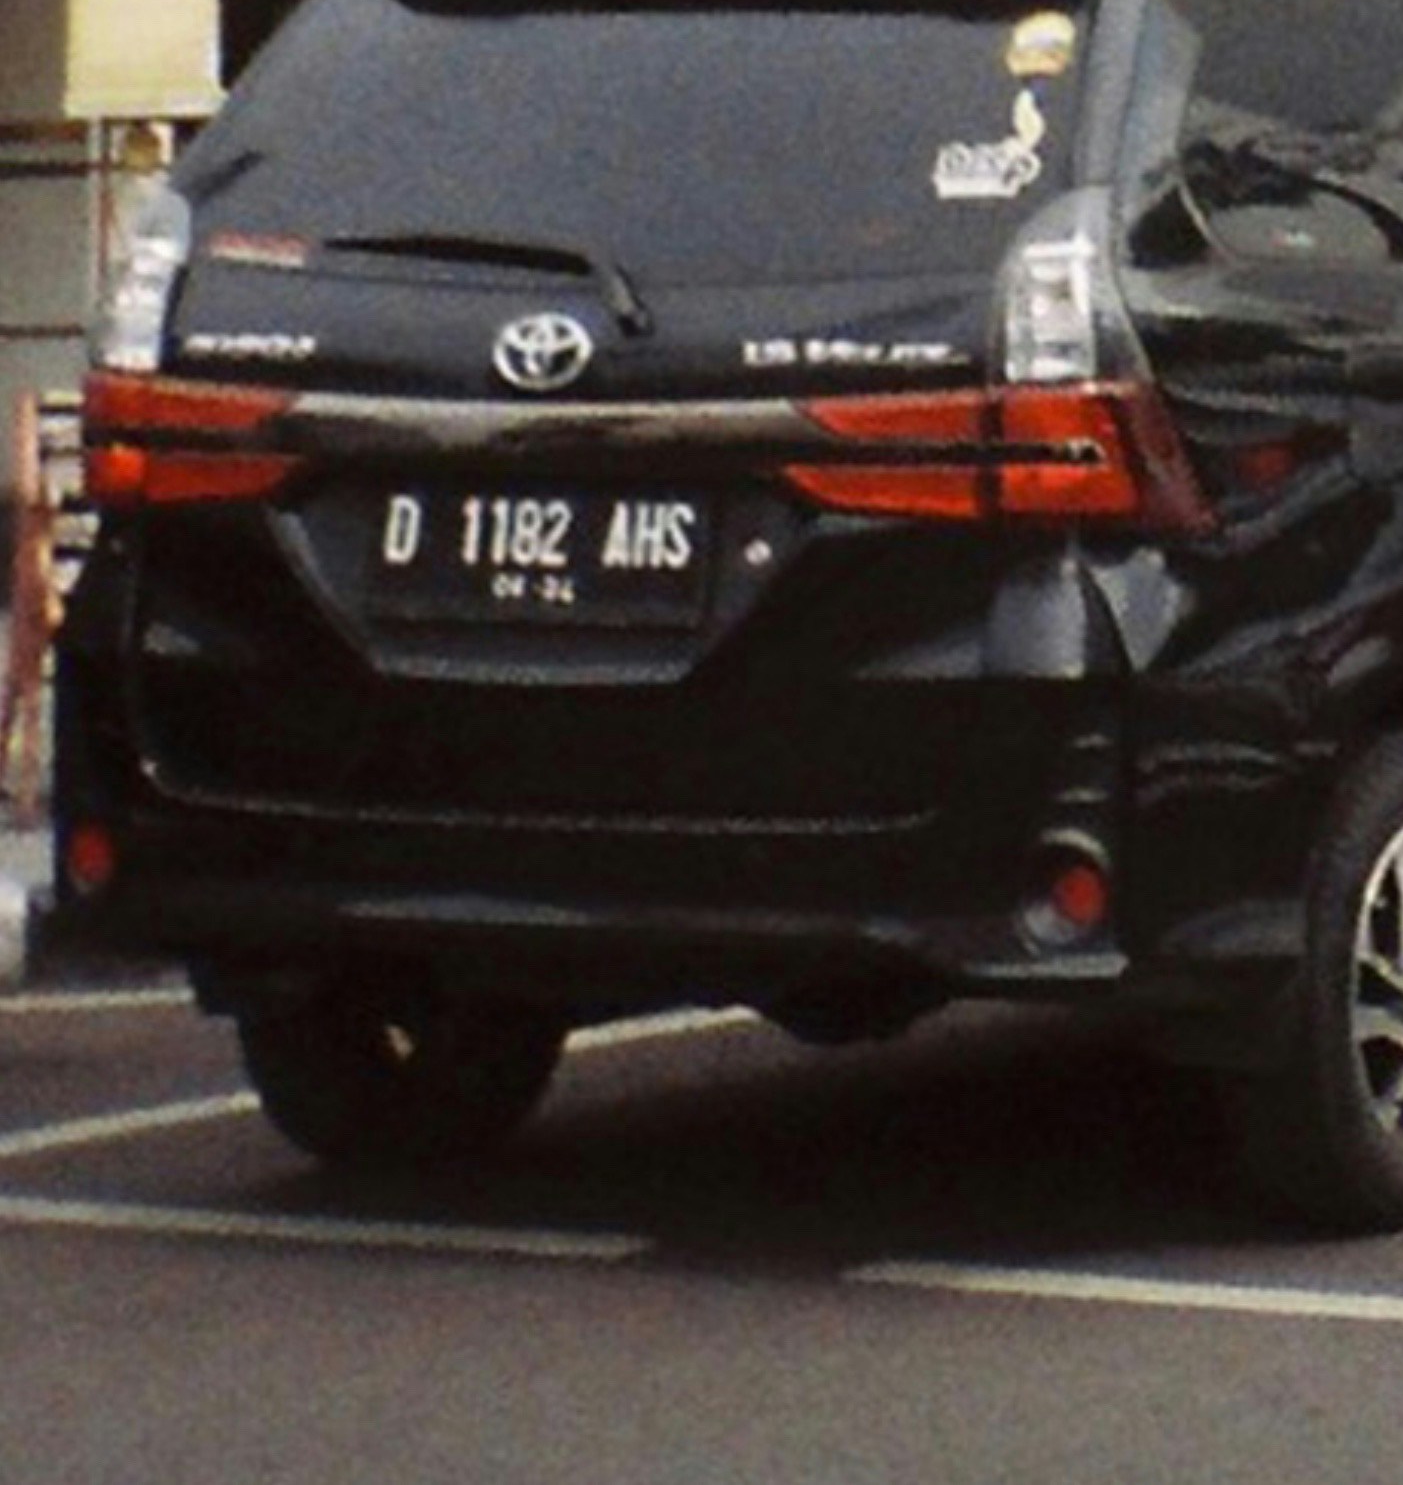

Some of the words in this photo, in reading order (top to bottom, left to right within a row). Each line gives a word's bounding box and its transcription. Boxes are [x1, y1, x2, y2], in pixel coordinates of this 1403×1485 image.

[384, 495, 421, 564] D
[461, 497, 572, 567] 1182
[602, 501, 696, 569] AHS
